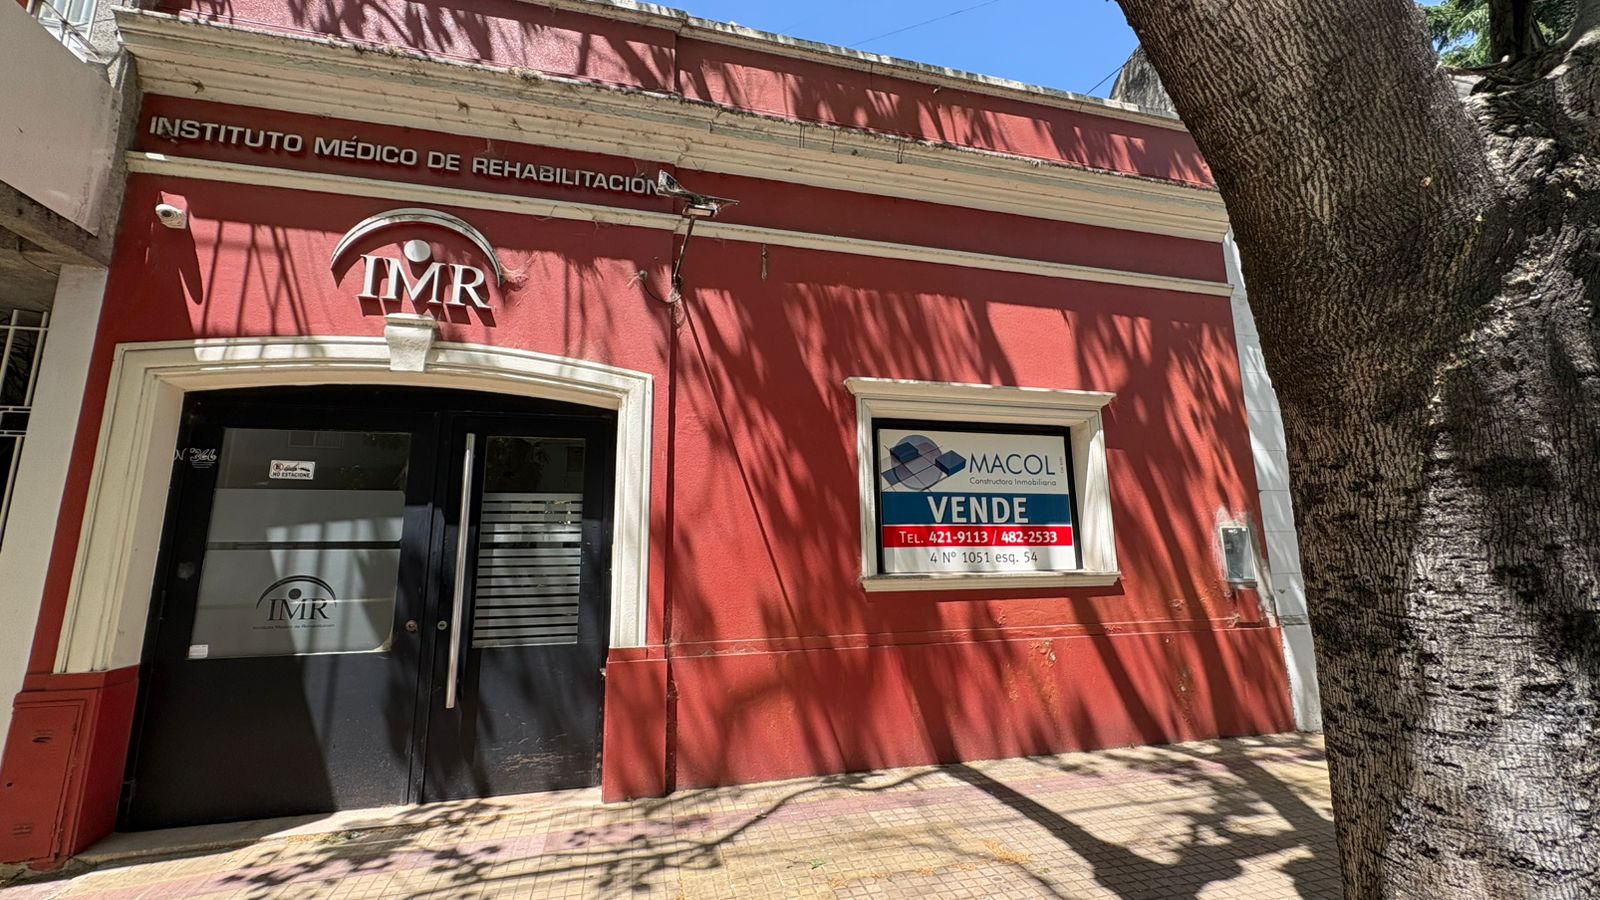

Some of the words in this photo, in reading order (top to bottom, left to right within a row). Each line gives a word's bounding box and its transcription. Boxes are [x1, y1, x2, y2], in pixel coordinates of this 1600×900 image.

[149, 116, 302, 152] INSTITUTO
[314, 135, 417, 166] MÉDICO
[427, 151, 461, 171] DE
[472, 157, 659, 195] REHABILITACIÓN
[355, 254, 492, 309] IMR
[969, 452, 1055, 476] MACOL
[969, 476, 1013, 486] Constructora
[1014, 478, 1057, 487] Inmobiliaria
[927, 496, 1029, 524] VENDE
[929, 531, 988, 544] 421-9113
[1001, 531, 1057, 543] 482-2533
[930, 552, 938, 564] 4
[962, 552, 990, 563] 1051
[995, 554, 1019, 566] esq.
[1024, 552, 1038, 562] 54
[267, 599, 330, 621] IMR
